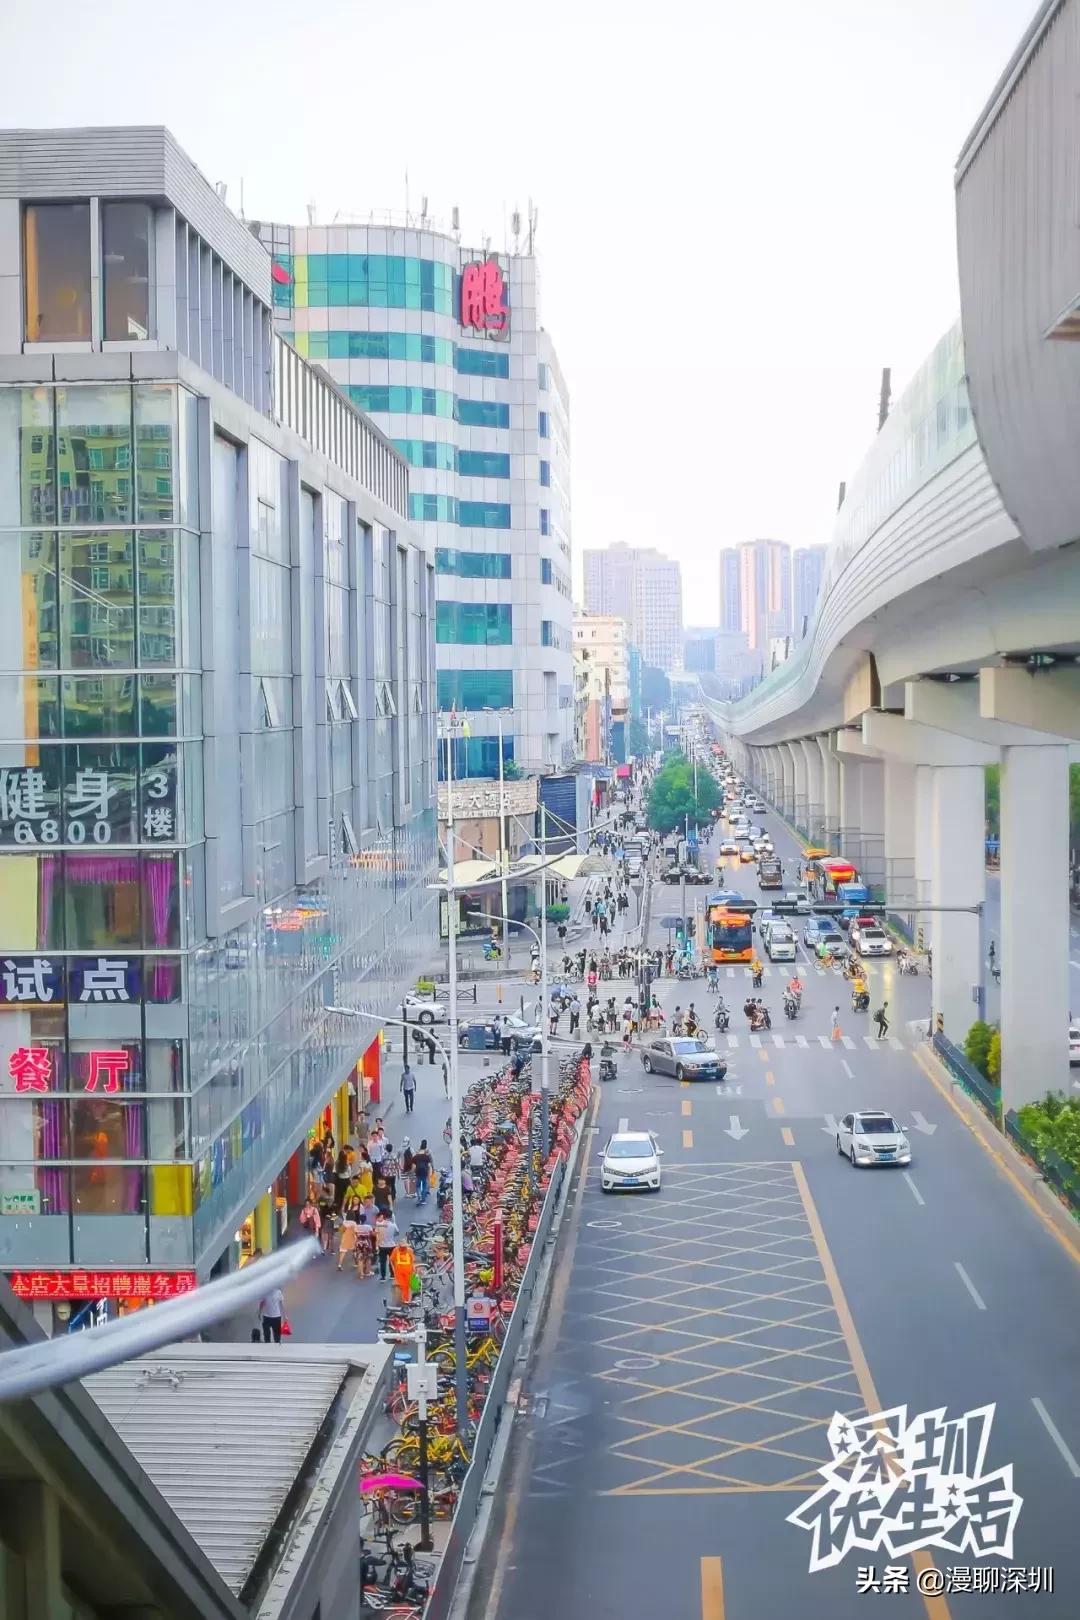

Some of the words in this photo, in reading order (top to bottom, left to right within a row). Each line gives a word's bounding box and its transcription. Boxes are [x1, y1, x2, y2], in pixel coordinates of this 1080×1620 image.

[0, 768, 118, 821] 健身
[2, 958, 131, 1002] 试点
[8, 1047, 129, 1093] 餐厅
